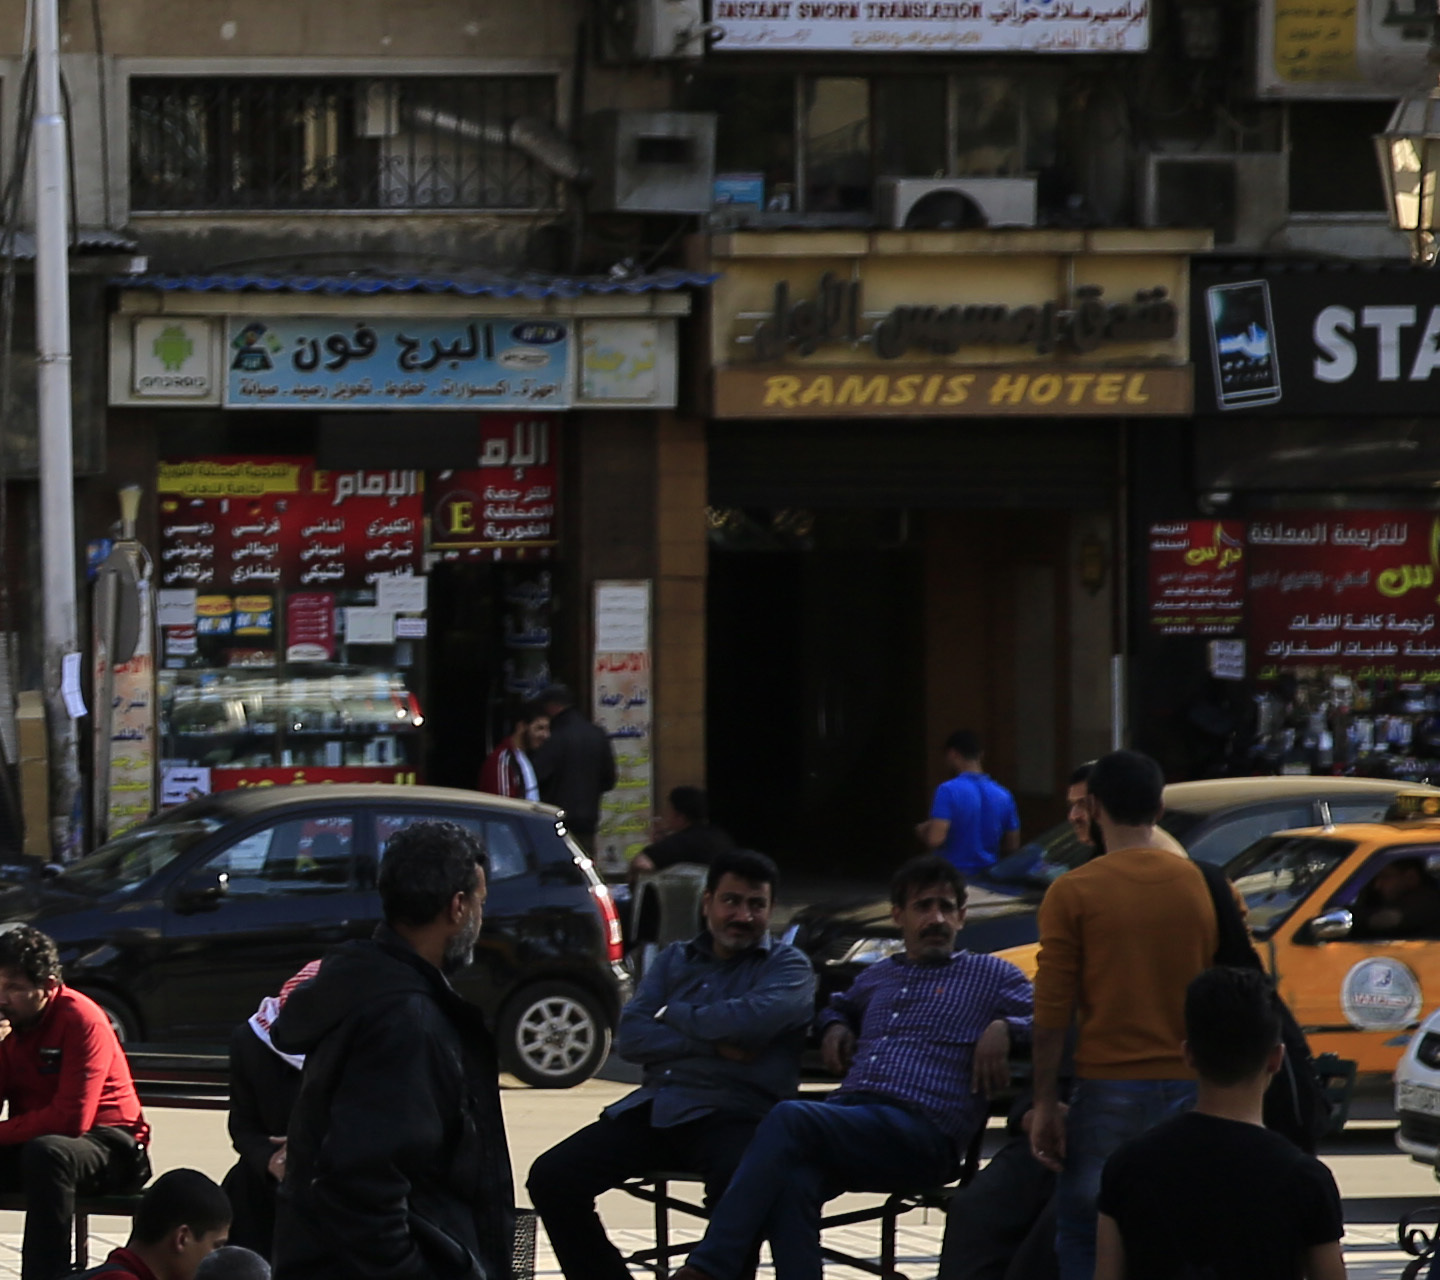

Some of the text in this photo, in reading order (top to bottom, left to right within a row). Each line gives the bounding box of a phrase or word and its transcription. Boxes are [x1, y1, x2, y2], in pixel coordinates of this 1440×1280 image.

[718, 0, 982, 19] INSTANT SWORN TRANSLATION
[292, 320, 495, 372] البرج فون
[763, 372, 1149, 409] RAMSIS HOTEL
[332, 470, 417, 507] الإمام
[164, 522, 214, 537] روسي
[449, 502, 475, 533] E
[1250, 522, 1408, 551] للترجمة المحلفة
[1289, 613, 1435, 635] ترجمة كافة اللغات
[1266, 640, 1341, 659] السفارات
